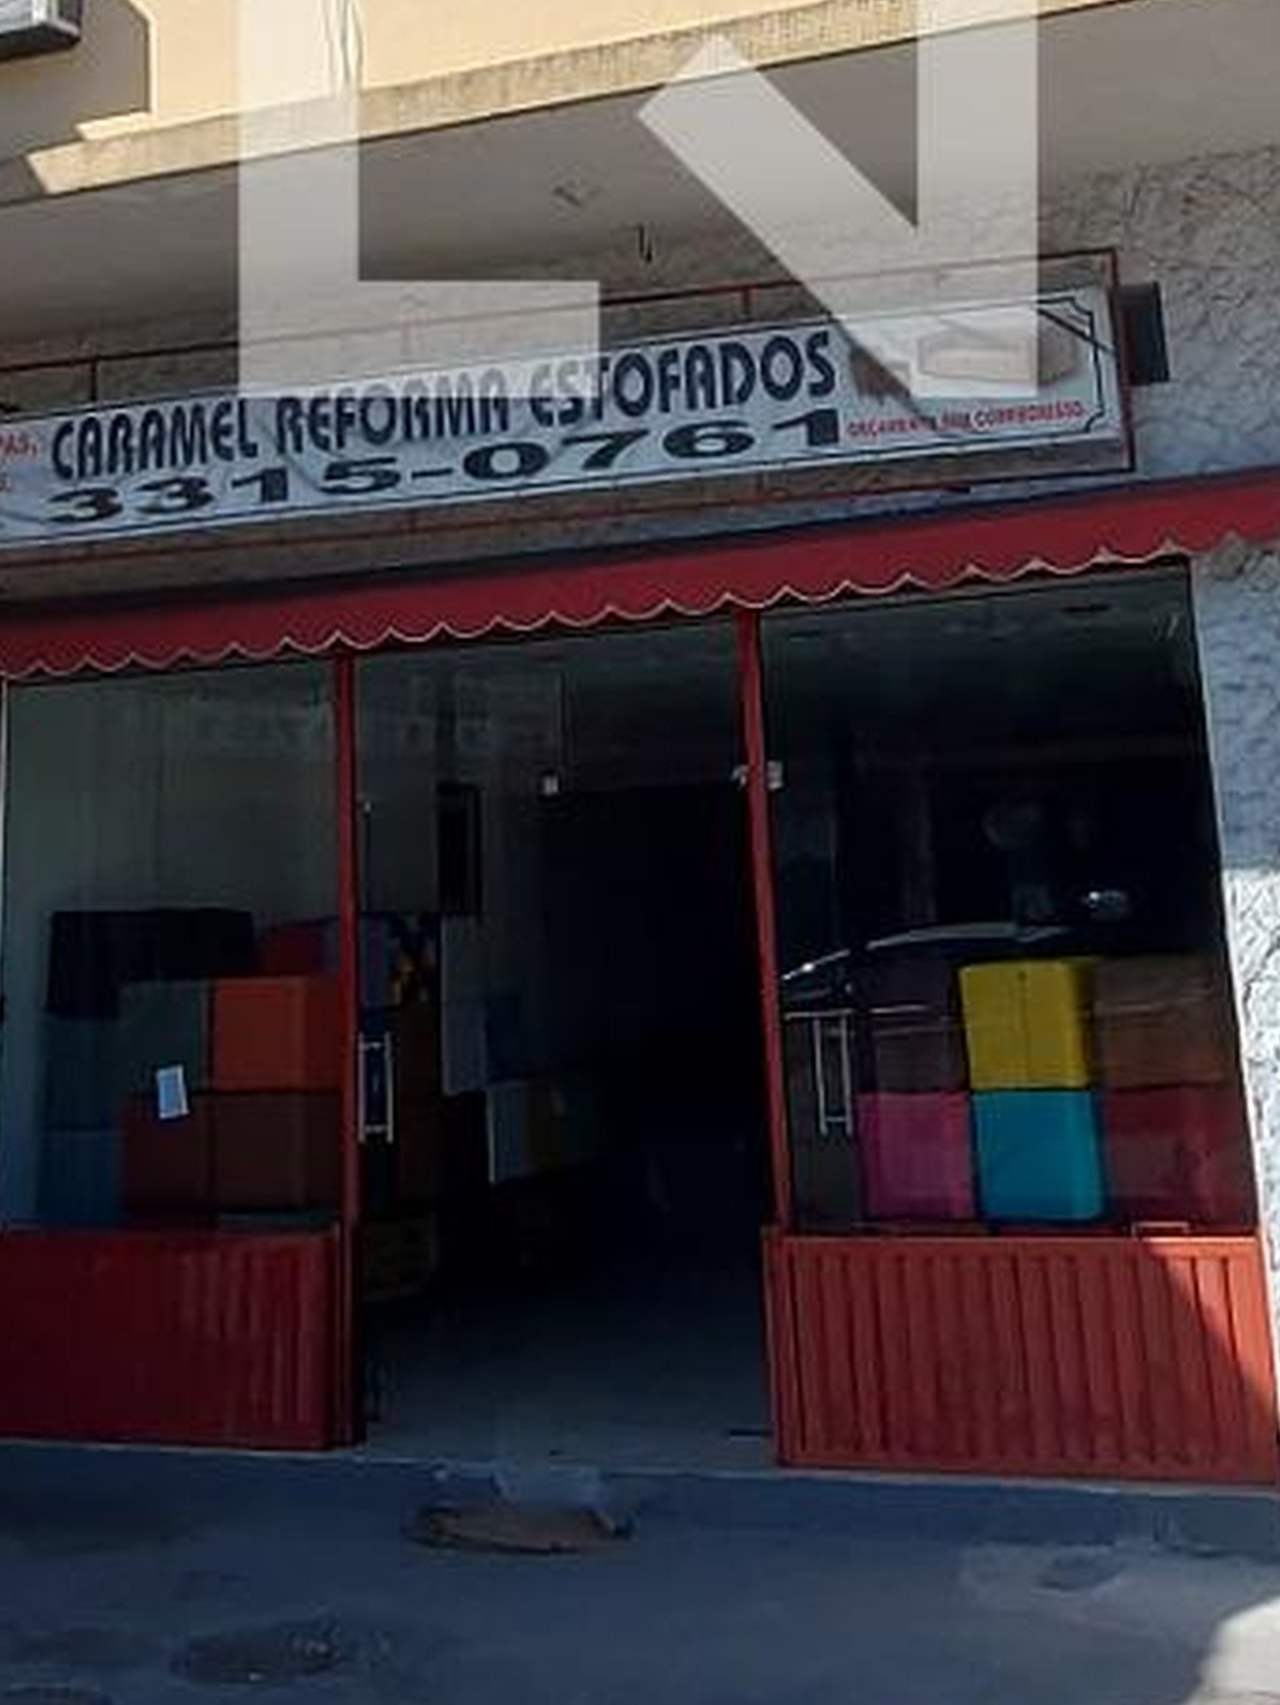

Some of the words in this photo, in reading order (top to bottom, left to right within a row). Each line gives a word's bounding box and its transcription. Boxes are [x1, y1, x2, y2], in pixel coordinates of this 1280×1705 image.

[45, 408, 840, 523] 3315-0761
[51, 398, 257, 481] CARAMEL
[276, 370, 510, 454] REFORMA
[530, 331, 836, 426] ESTOFADOS
